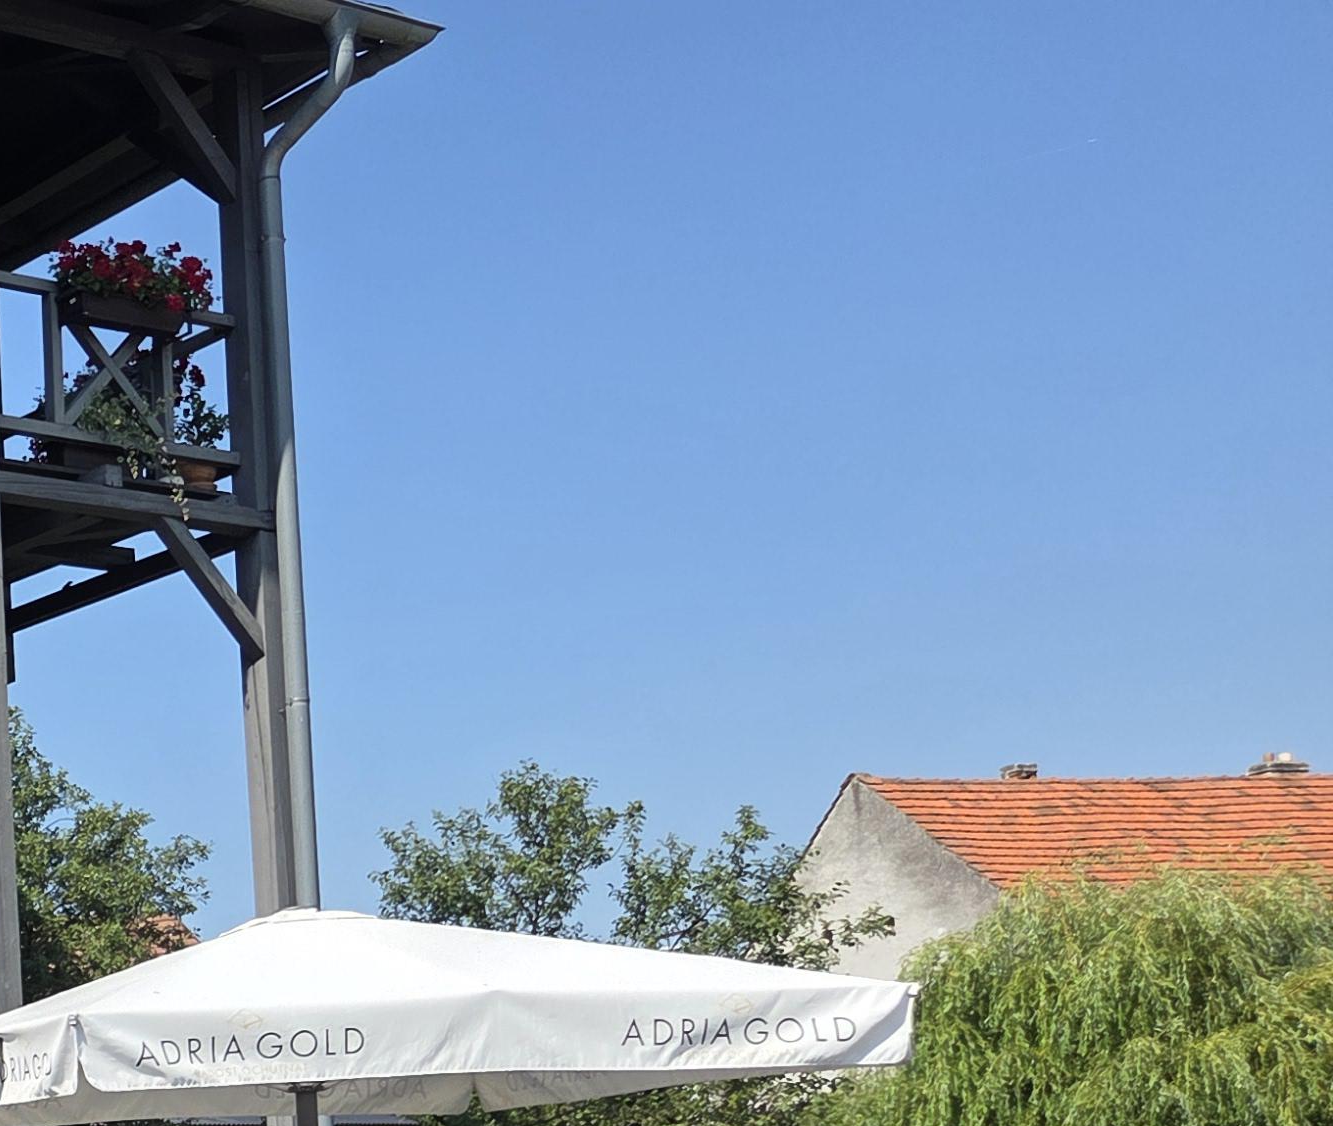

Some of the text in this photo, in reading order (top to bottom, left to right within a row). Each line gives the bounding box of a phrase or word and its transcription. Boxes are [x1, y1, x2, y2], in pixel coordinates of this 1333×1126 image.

[136, 1027, 366, 1068] ADRIA GOLD
[622, 1017, 857, 1046] ADRIA GOLD
